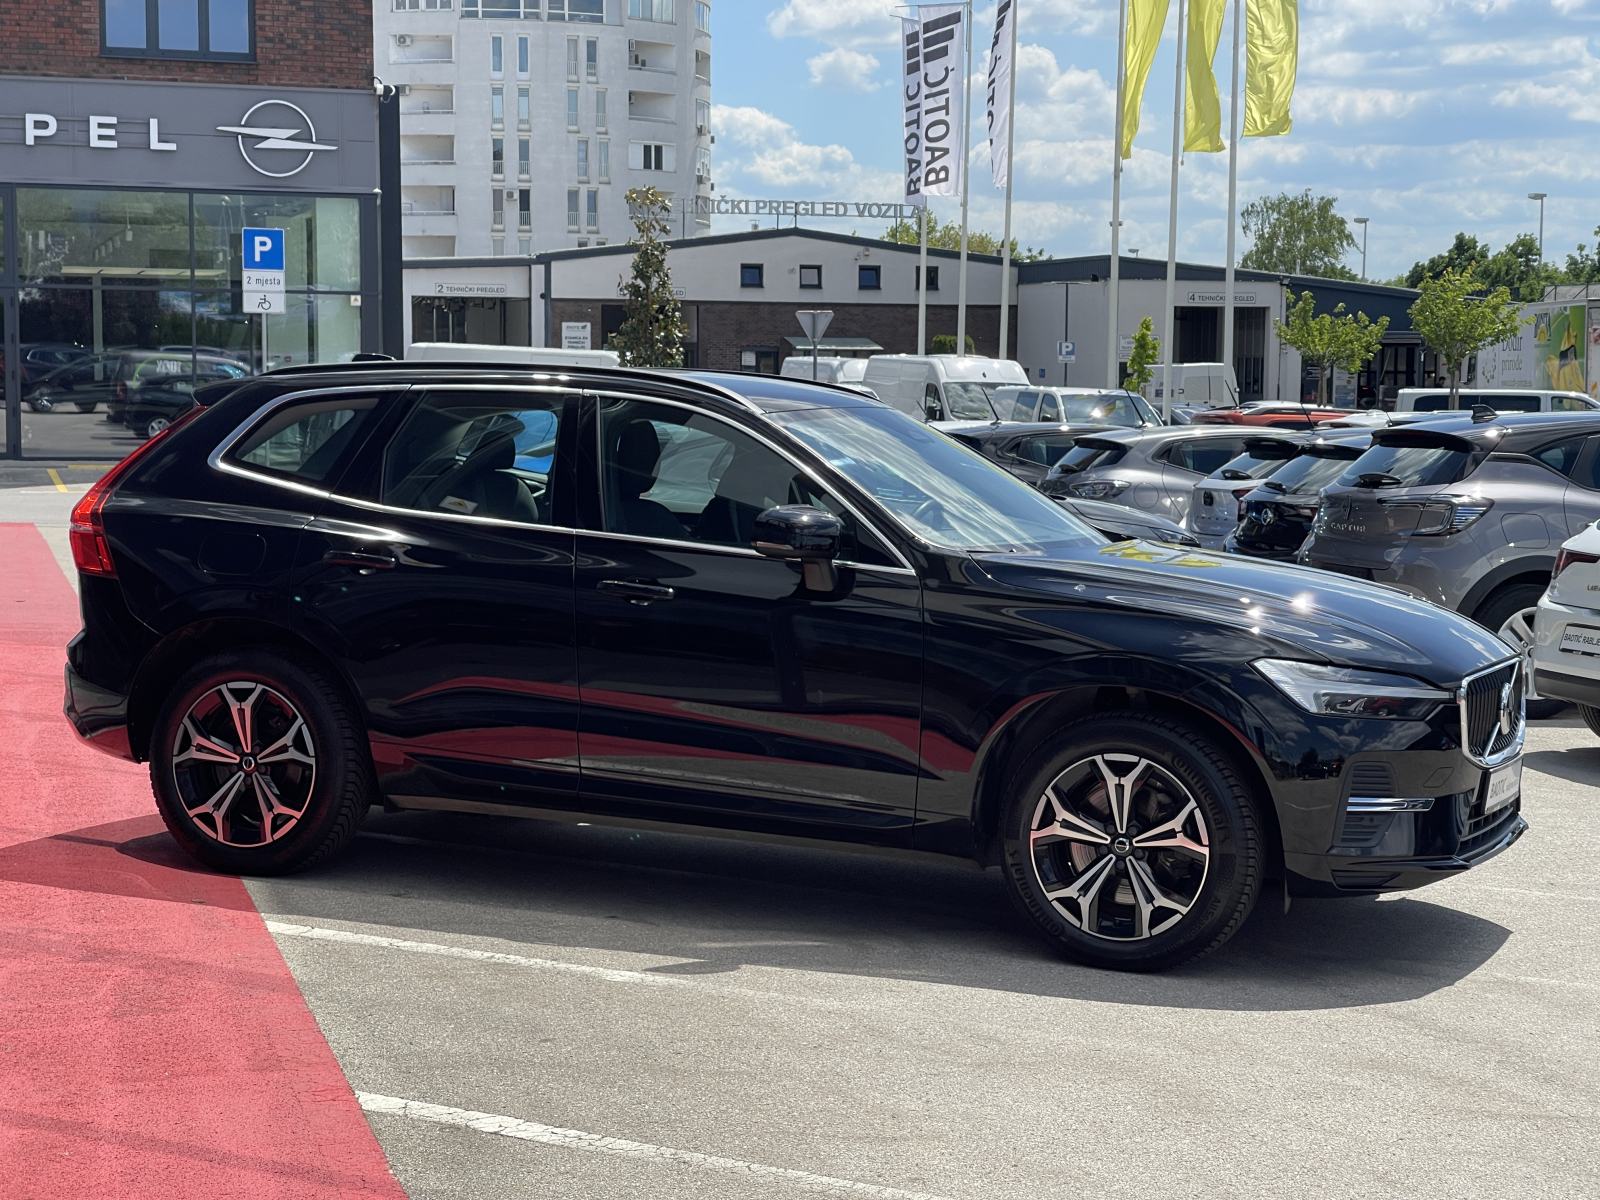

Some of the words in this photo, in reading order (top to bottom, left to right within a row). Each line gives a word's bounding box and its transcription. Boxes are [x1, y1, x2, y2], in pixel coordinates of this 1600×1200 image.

[755, 199, 848, 217] PREGLED
[855, 202, 920, 218] VOZILA
[254, 236, 272, 262] P
[246, 276, 252, 285] 2
[255, 276, 281, 287] mjesta
[437, 284, 444, 293] 2
[1189, 293, 1195, 302] 4
[1061, 342, 1073, 355] P
